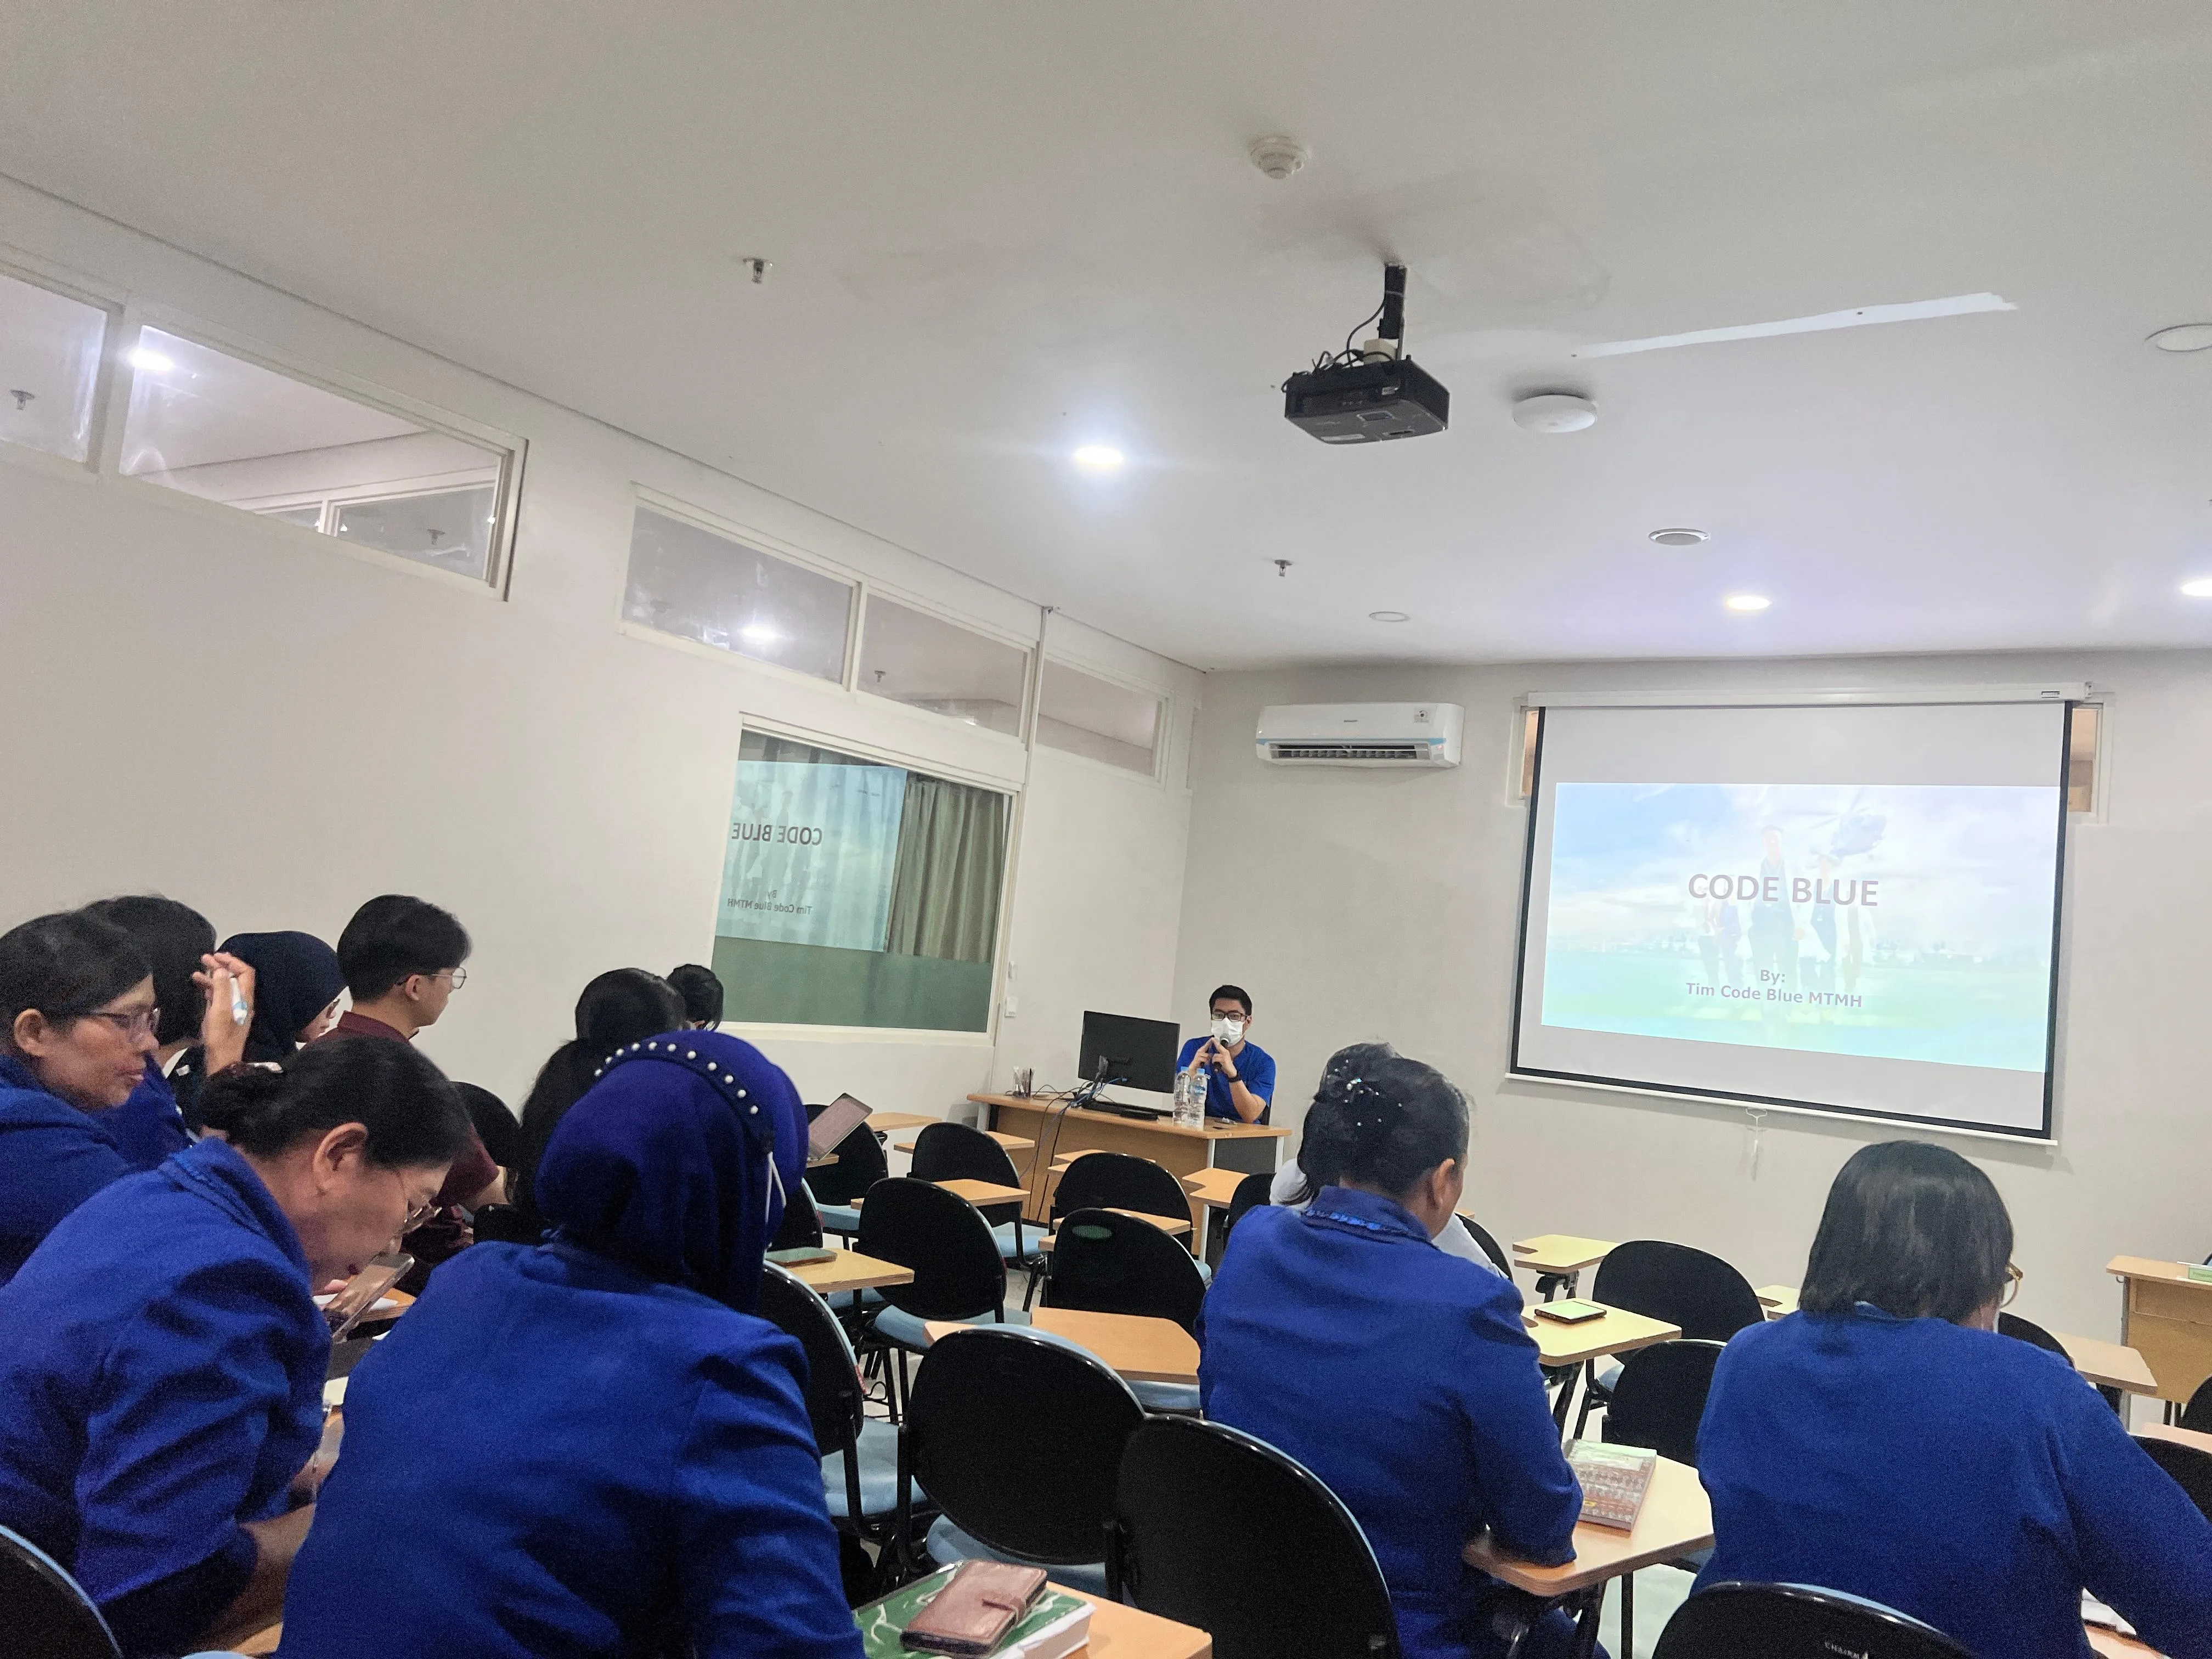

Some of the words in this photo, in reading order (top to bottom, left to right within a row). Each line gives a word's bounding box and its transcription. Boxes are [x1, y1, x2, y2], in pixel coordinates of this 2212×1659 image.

[1688, 873, 1780, 902] CODE
[1792, 877, 1880, 907] BLUE
[1760, 969, 1786, 985] By:
[1686, 983, 1716, 997] Tim
[1720, 985, 1761, 1000] Code
[1767, 989, 1803, 1003] Blue
[1808, 992, 1863, 1008] MTMH
